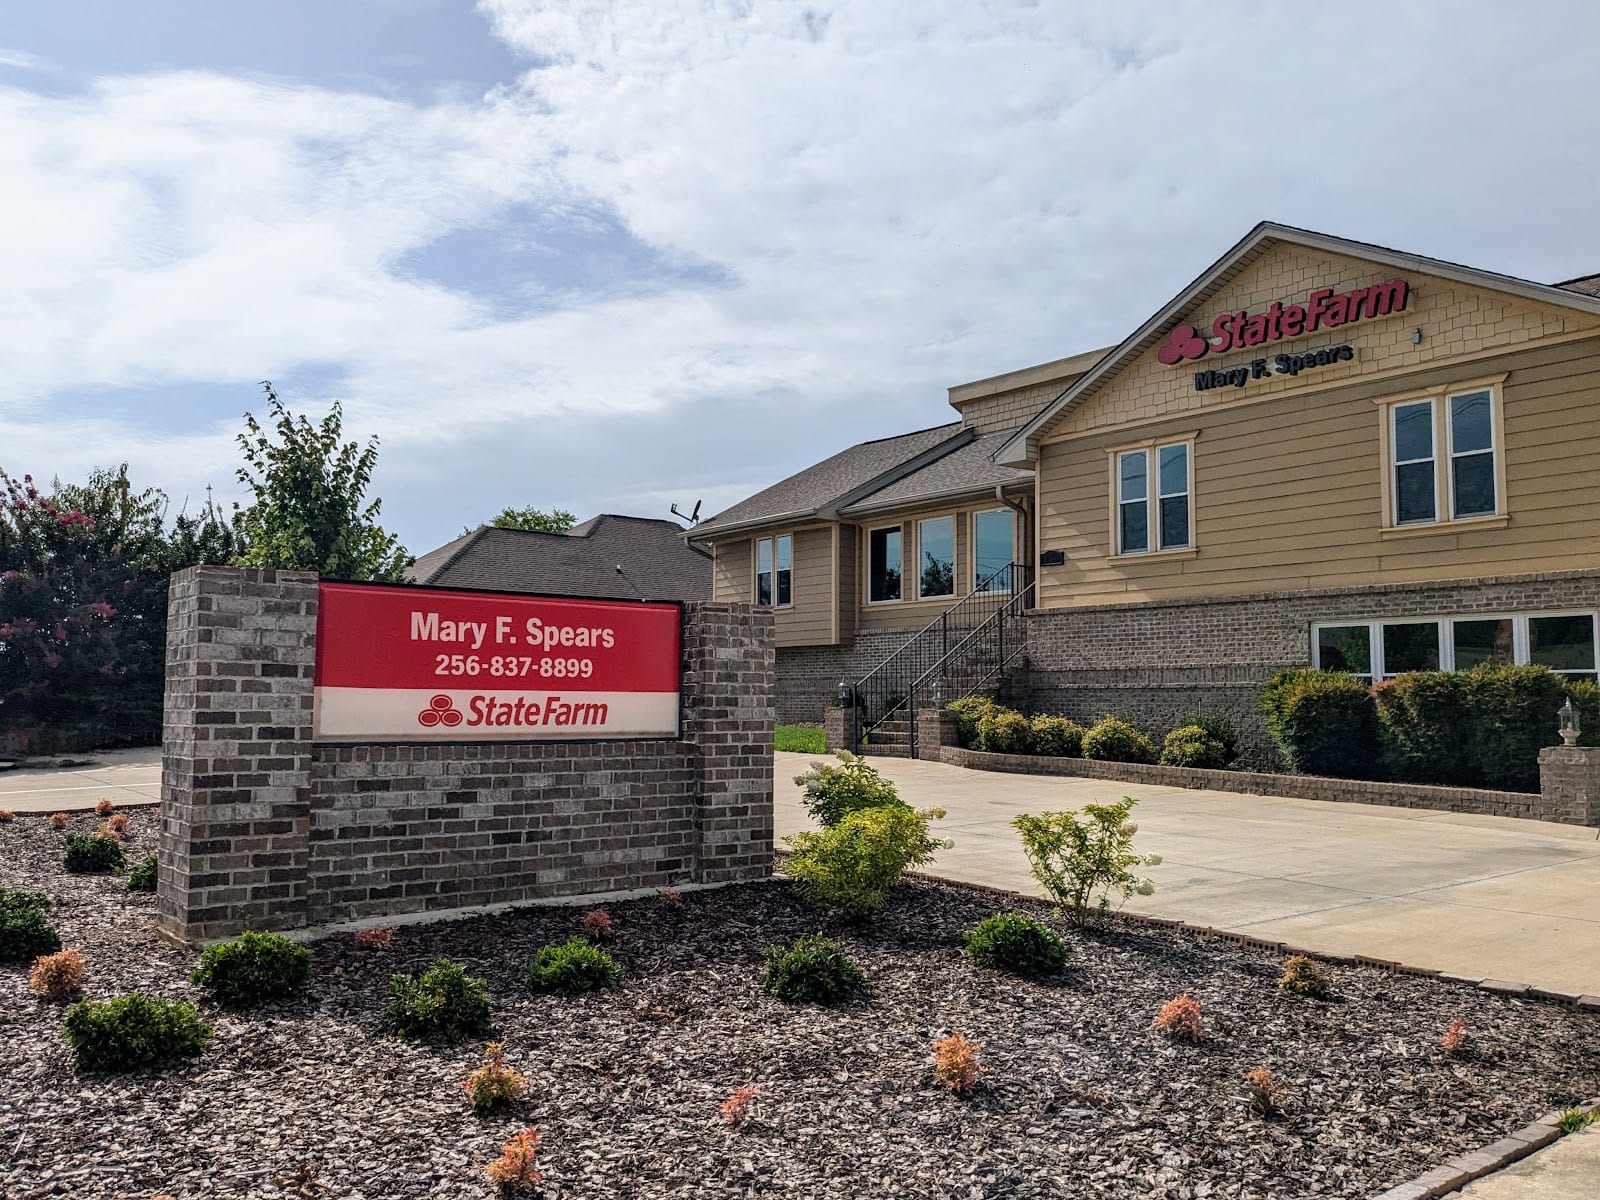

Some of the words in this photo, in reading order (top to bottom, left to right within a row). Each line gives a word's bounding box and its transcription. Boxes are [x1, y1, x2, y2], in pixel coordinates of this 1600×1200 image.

[1194, 364, 1250, 391] Mary
[1251, 358, 1272, 380] F.
[1274, 344, 1354, 376] Spears
[410, 611, 488, 650] Mary
[495, 616, 517, 645] F.
[525, 617, 615, 652] Spears
[434, 653, 594, 680] 256-837-8899
